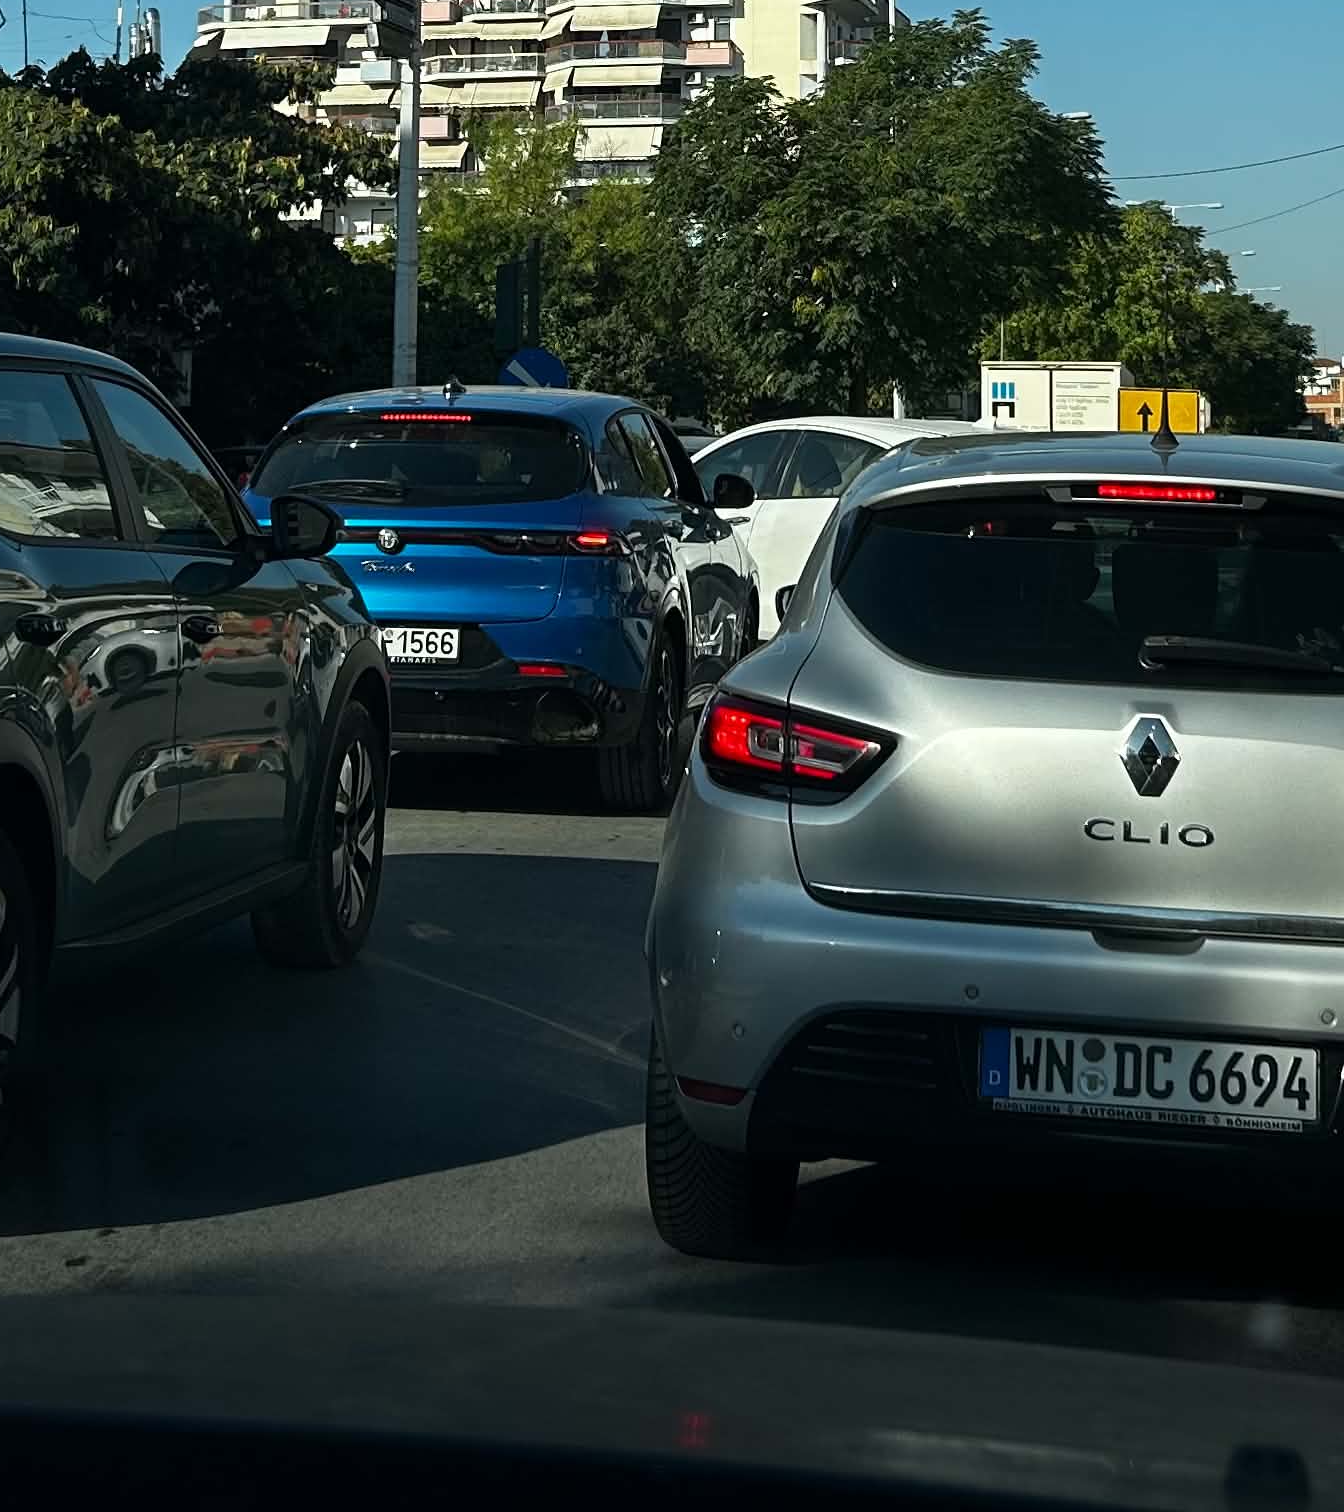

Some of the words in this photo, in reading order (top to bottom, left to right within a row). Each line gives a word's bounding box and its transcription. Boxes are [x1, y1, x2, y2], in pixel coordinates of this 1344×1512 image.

[1083, 816, 1216, 848] CLIO
[989, 1069, 1002, 1086] D
[1014, 1035, 1075, 1095] WN
[1113, 1042, 1174, 1100] DC
[1189, 1048, 1311, 1111] 6694
[1079, 1104, 1153, 1120] AUTOHAUS
